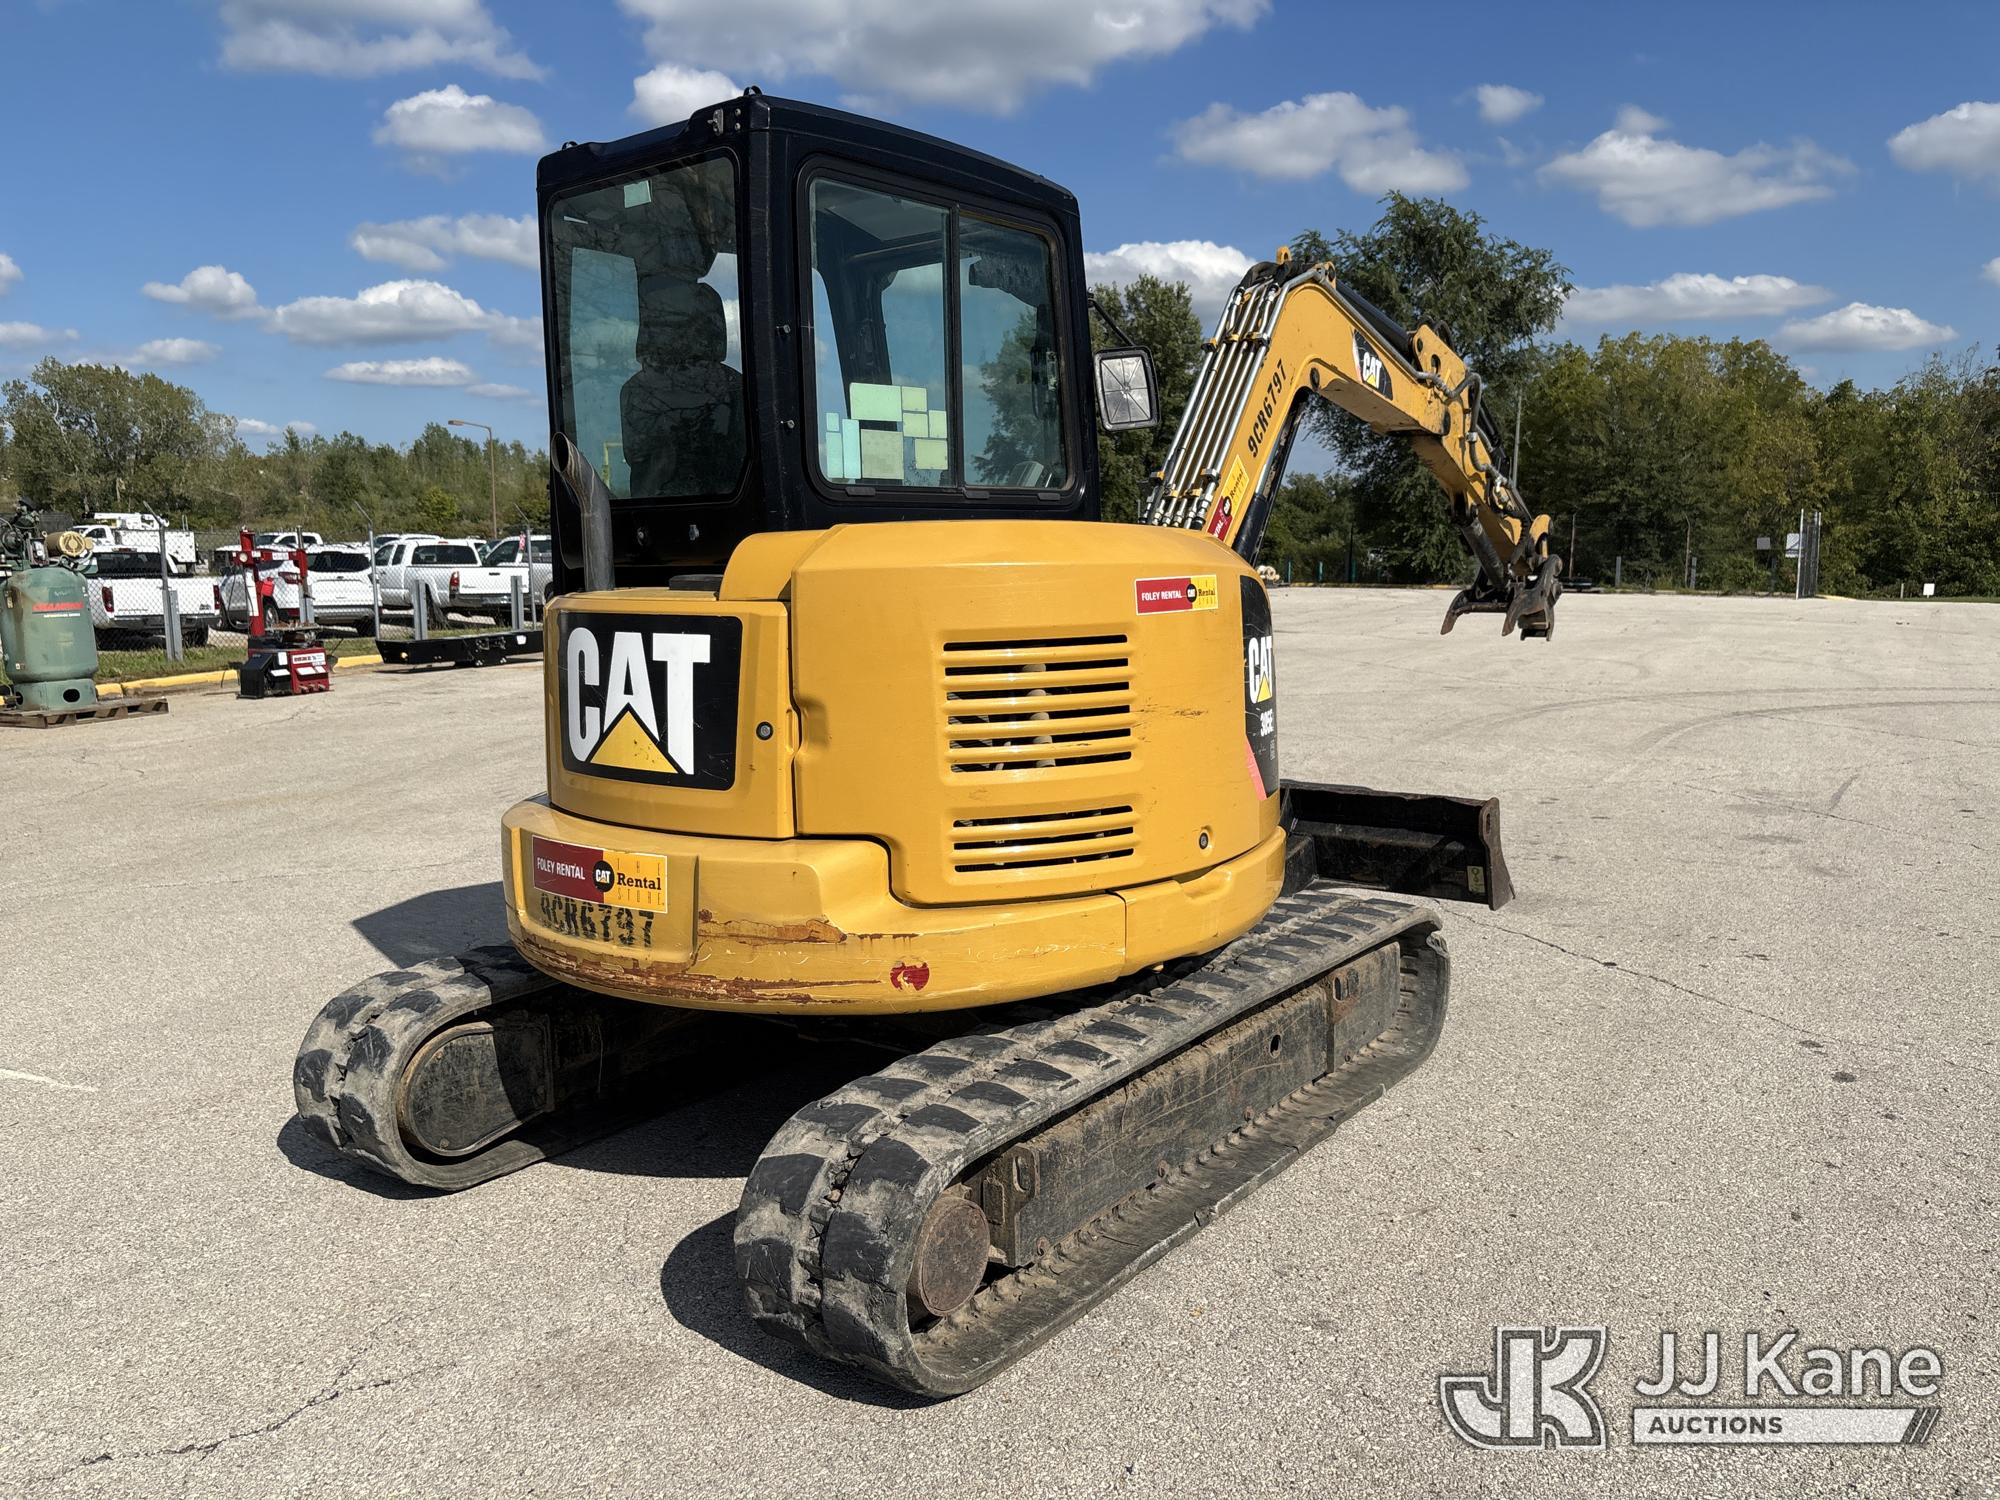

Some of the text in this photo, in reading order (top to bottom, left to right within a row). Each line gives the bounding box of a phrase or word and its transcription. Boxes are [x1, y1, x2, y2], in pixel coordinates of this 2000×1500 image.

[1363, 352, 1382, 389] CAT
[1248, 358, 1287, 458] 9CR6797
[1141, 590, 1183, 601] FOLEY RENTAL
[1198, 588, 1216, 597] Rental
[1248, 635, 1273, 704] CAT
[567, 627, 711, 775] CAT
[536, 857, 586, 880] FOLEY RENTAL
[595, 868, 611, 883] CAT
[616, 872, 662, 891] Rental
